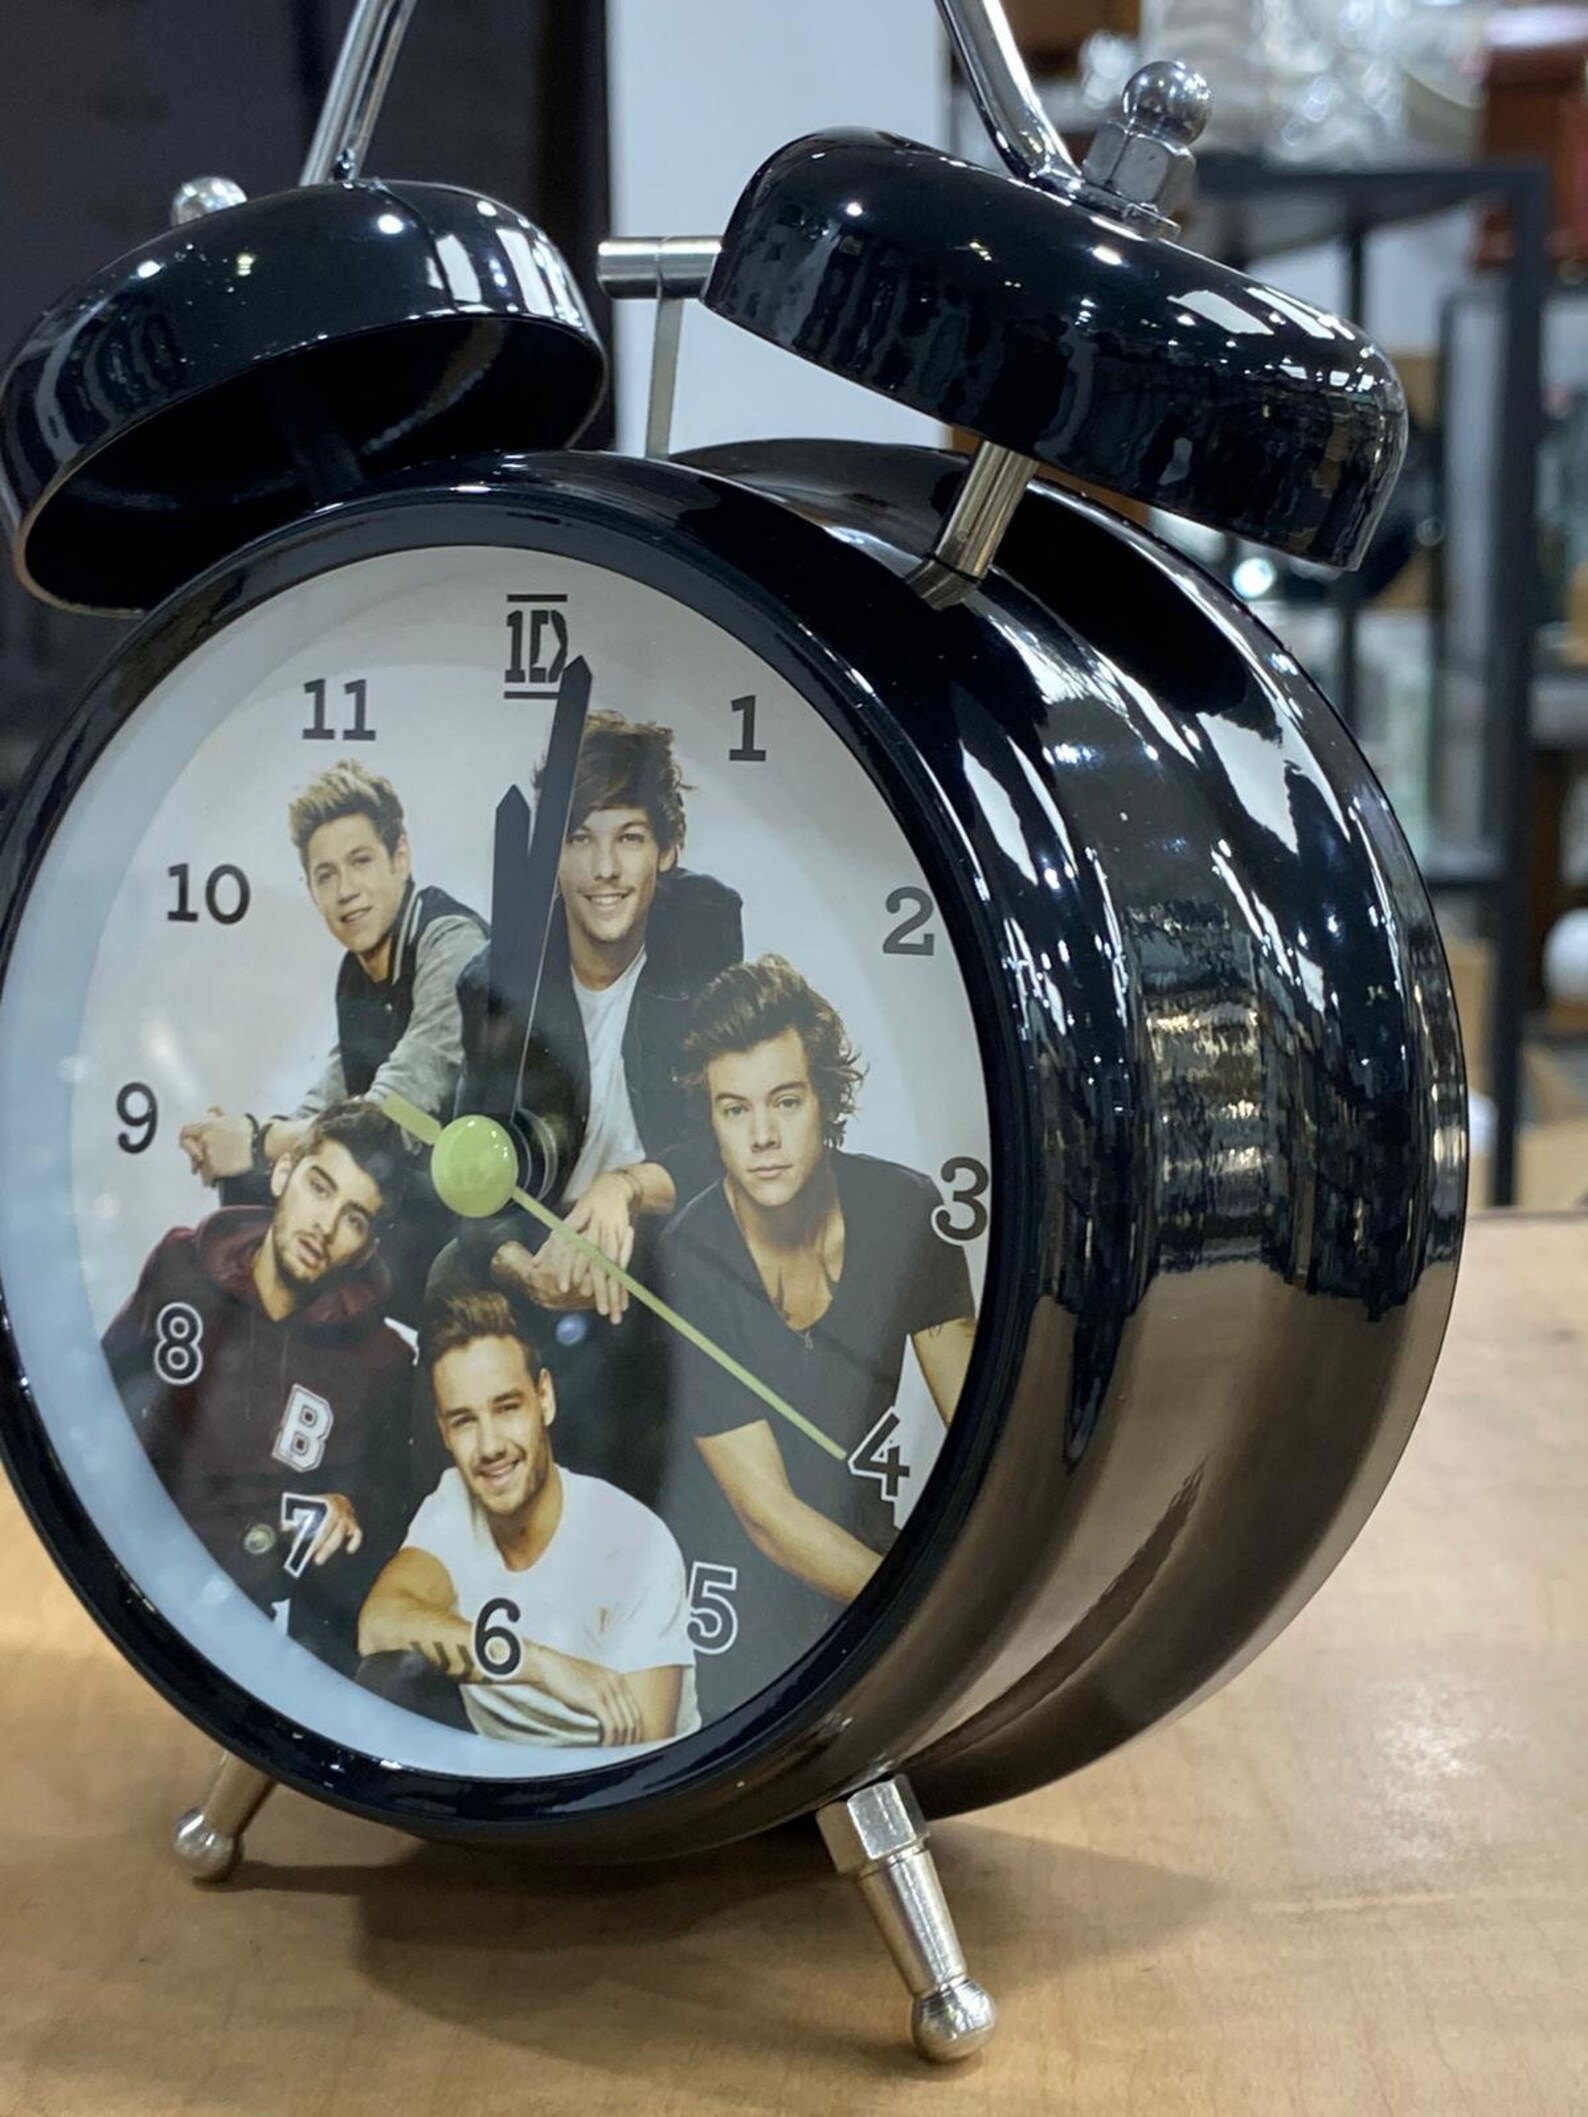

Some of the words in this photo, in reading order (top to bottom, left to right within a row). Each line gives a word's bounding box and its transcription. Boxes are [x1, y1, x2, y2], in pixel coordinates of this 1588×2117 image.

[302, 678, 376, 741] 11
[729, 694, 766, 762] 1
[167, 863, 250, 925] 10
[882, 886, 934, 956] 2
[115, 1082, 158, 1154] 9
[931, 1155, 989, 1246] 3
[155, 1302, 203, 1386] 8
[271, 1383, 333, 1472] B
[848, 1406, 912, 1503] 4
[281, 1492, 328, 1578] 7
[472, 1596, 522, 1680] 6
[686, 1561, 738, 1655] 5
